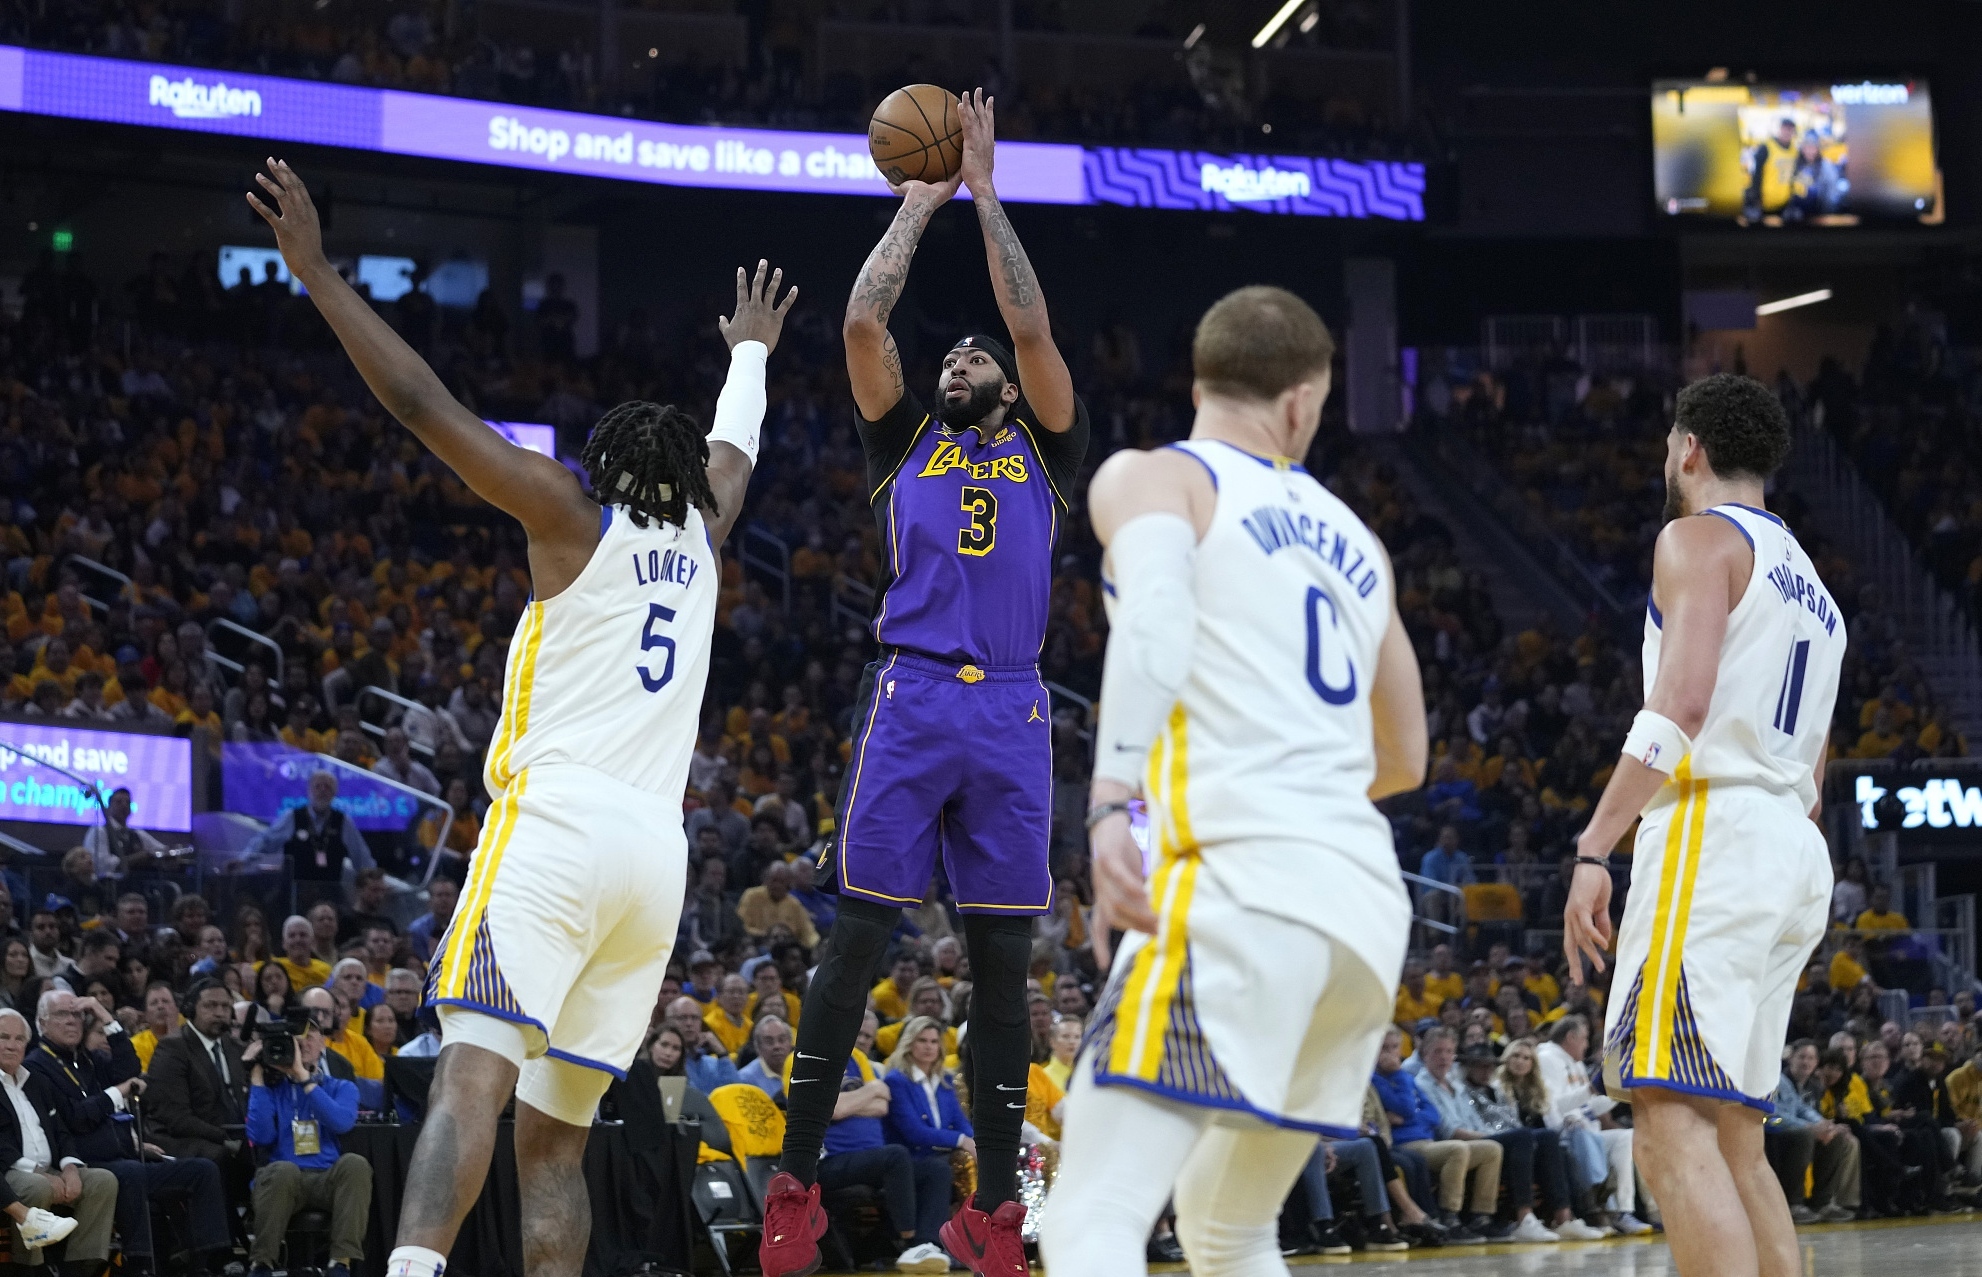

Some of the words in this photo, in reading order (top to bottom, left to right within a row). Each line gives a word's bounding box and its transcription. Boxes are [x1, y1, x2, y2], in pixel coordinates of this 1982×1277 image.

[149, 75, 261, 117] Rakuten
[488, 116, 570, 162] Shop
[573, 131, 633, 164] and
[637, 140, 710, 172] save
[715, 140, 774, 175] like
[779, 150, 800, 176] a
[1201, 163, 1310, 200] Rakuten
[991, 431, 1017, 448] bibigo
[958, 486, 998, 557] 3
[636, 602, 676, 693] 5
[1773, 634, 1811, 737] 11
[21, 738, 69, 769] and
[73, 746, 129, 774] save
